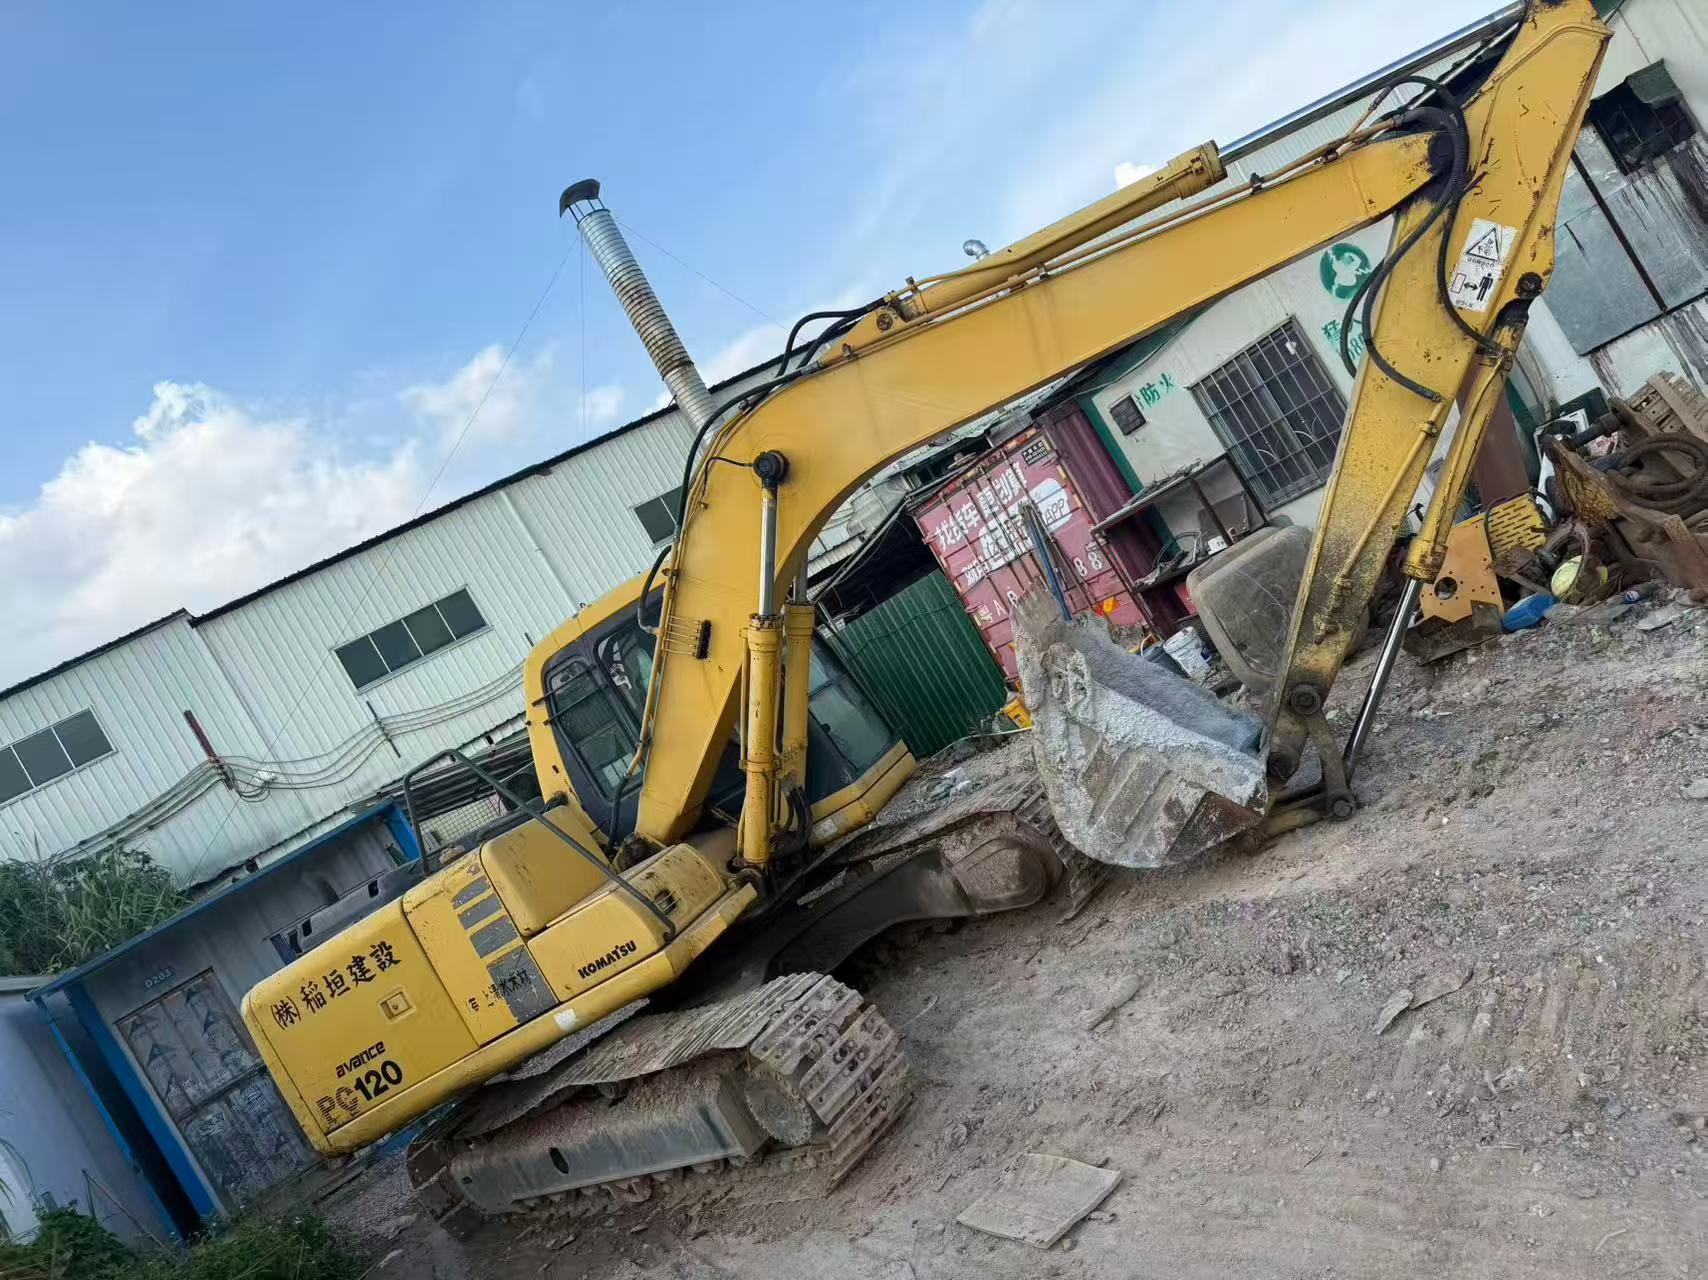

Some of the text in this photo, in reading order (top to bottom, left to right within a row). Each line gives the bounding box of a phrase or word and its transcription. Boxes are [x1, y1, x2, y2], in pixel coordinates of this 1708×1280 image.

[1046, 498, 1067, 525] APP
[577, 940, 637, 979] KOMATSU
[336, 1041, 386, 1079] avance
[316, 1060, 403, 1125] PC120
